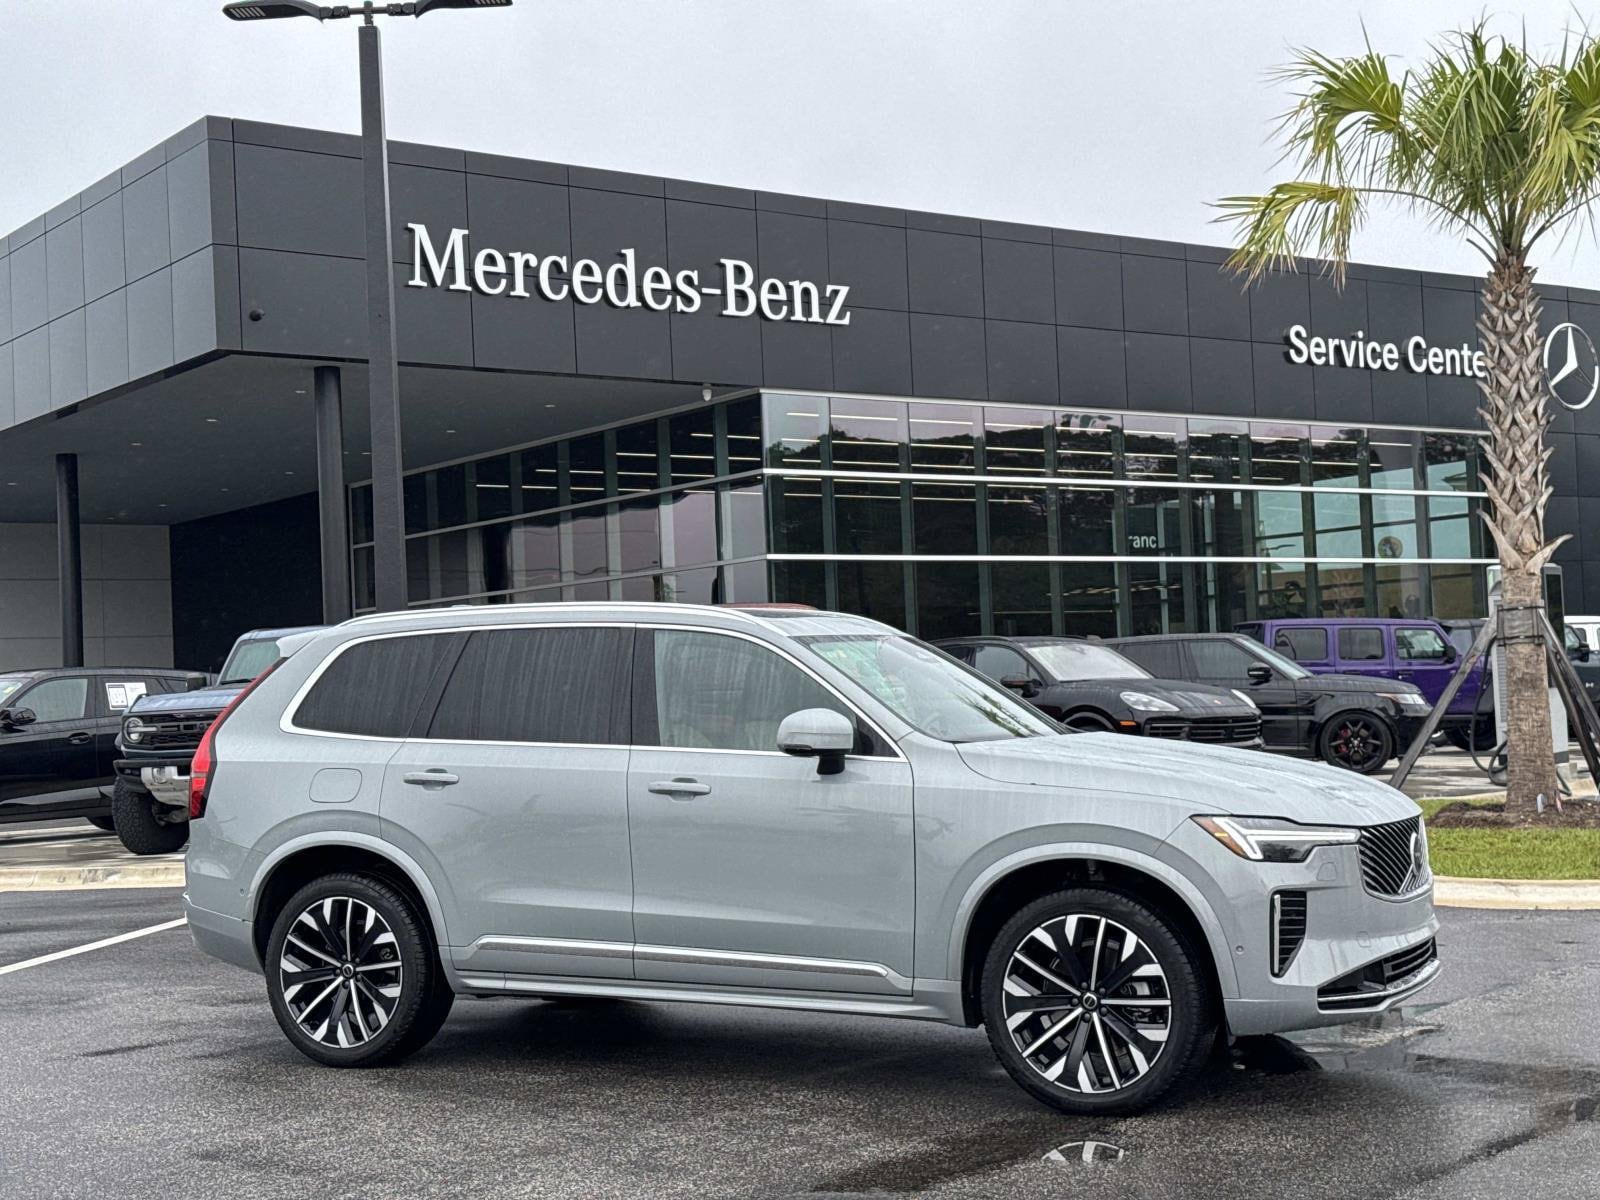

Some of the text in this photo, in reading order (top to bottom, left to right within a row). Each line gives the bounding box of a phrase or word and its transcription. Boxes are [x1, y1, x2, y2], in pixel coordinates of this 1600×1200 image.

[406, 221, 852, 326] Mercedes-Benz
[1289, 324, 1487, 378] Service Cente
